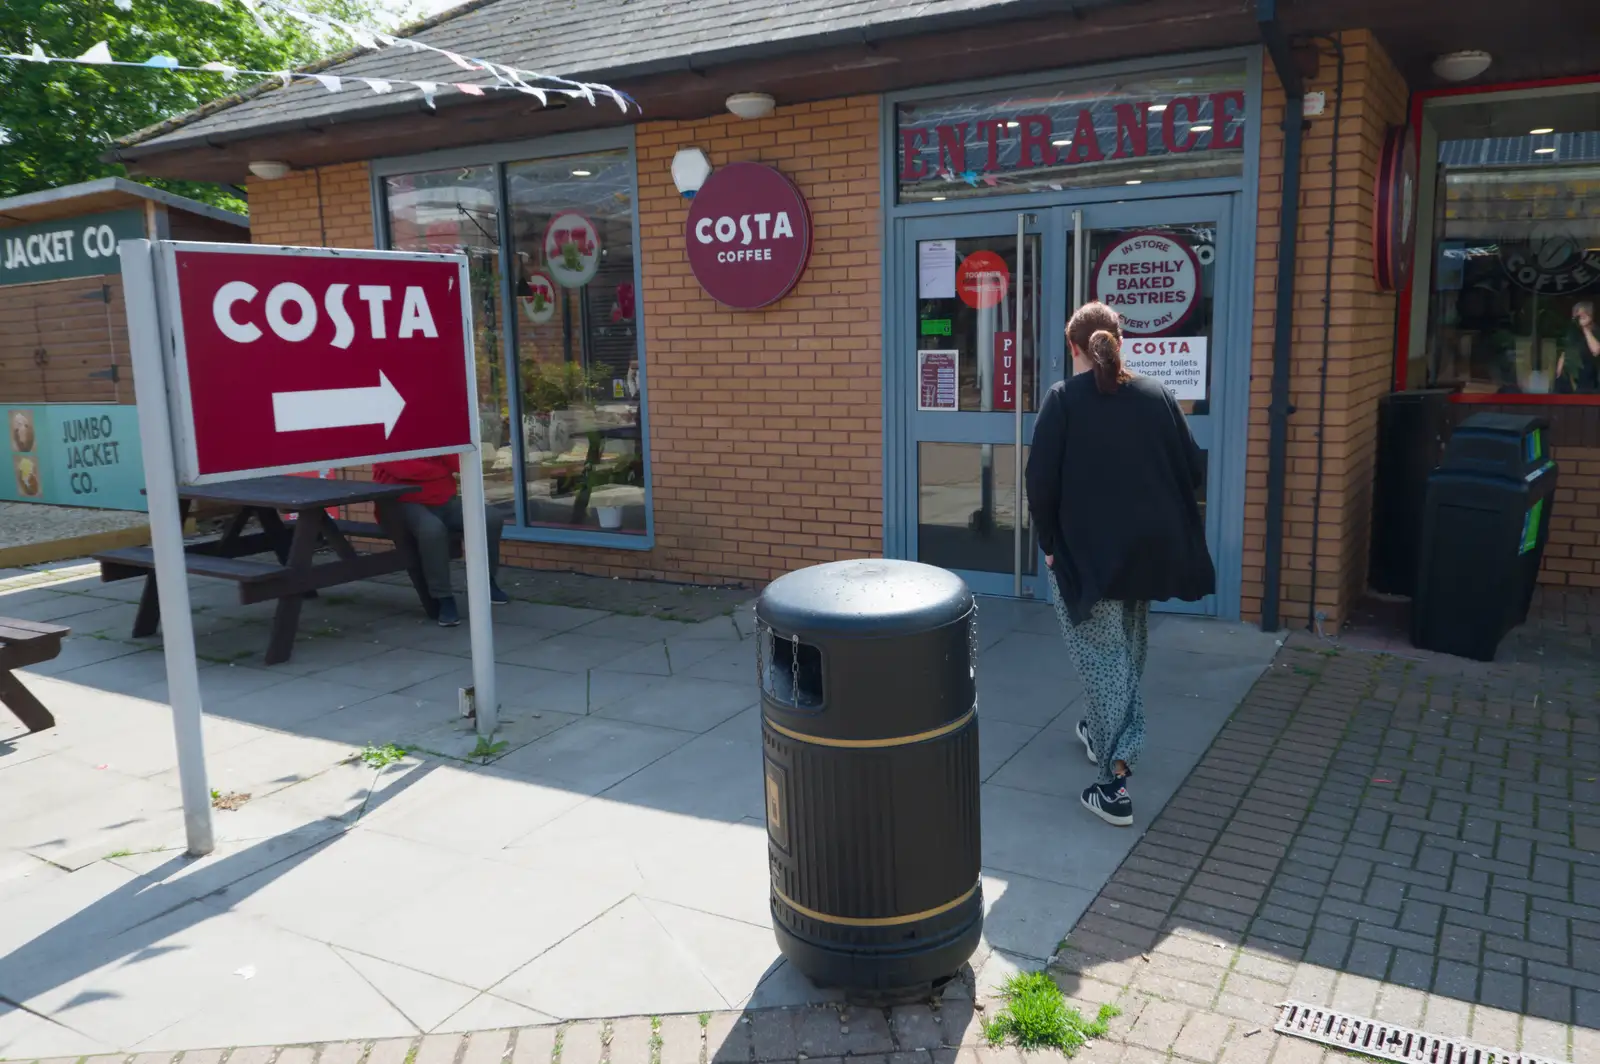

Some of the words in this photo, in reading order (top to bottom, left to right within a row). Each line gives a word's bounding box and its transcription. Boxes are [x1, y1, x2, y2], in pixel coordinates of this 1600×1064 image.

[900, 90, 1245, 181] ENTRANCE
[695, 211, 794, 245] COSTA
[4, 229, 74, 269] JACKET
[717, 248, 772, 263] COFFEE
[1121, 244, 1133, 255] IN
[1134, 240, 1171, 253] STORE
[1108, 259, 1184, 276] FRESHLY
[1117, 275, 1175, 290] BAKED
[1105, 290, 1186, 305] PASTRIES
[213, 280, 439, 349] COSTA
[1119, 314, 1150, 328] EVERY
[1153, 311, 1173, 327] DAY
[1132, 341, 1191, 356] COSTA
[1003, 338, 1013, 403] PULL
[1125, 360, 1166, 368] Customer
[1170, 359, 1198, 368] toilets
[1175, 367, 1200, 376] within
[1164, 377, 1199, 388] amenity
[63, 415, 113, 444] JUMBO
[66, 441, 120, 470] JACKET
[71, 473, 98, 496] CO.
